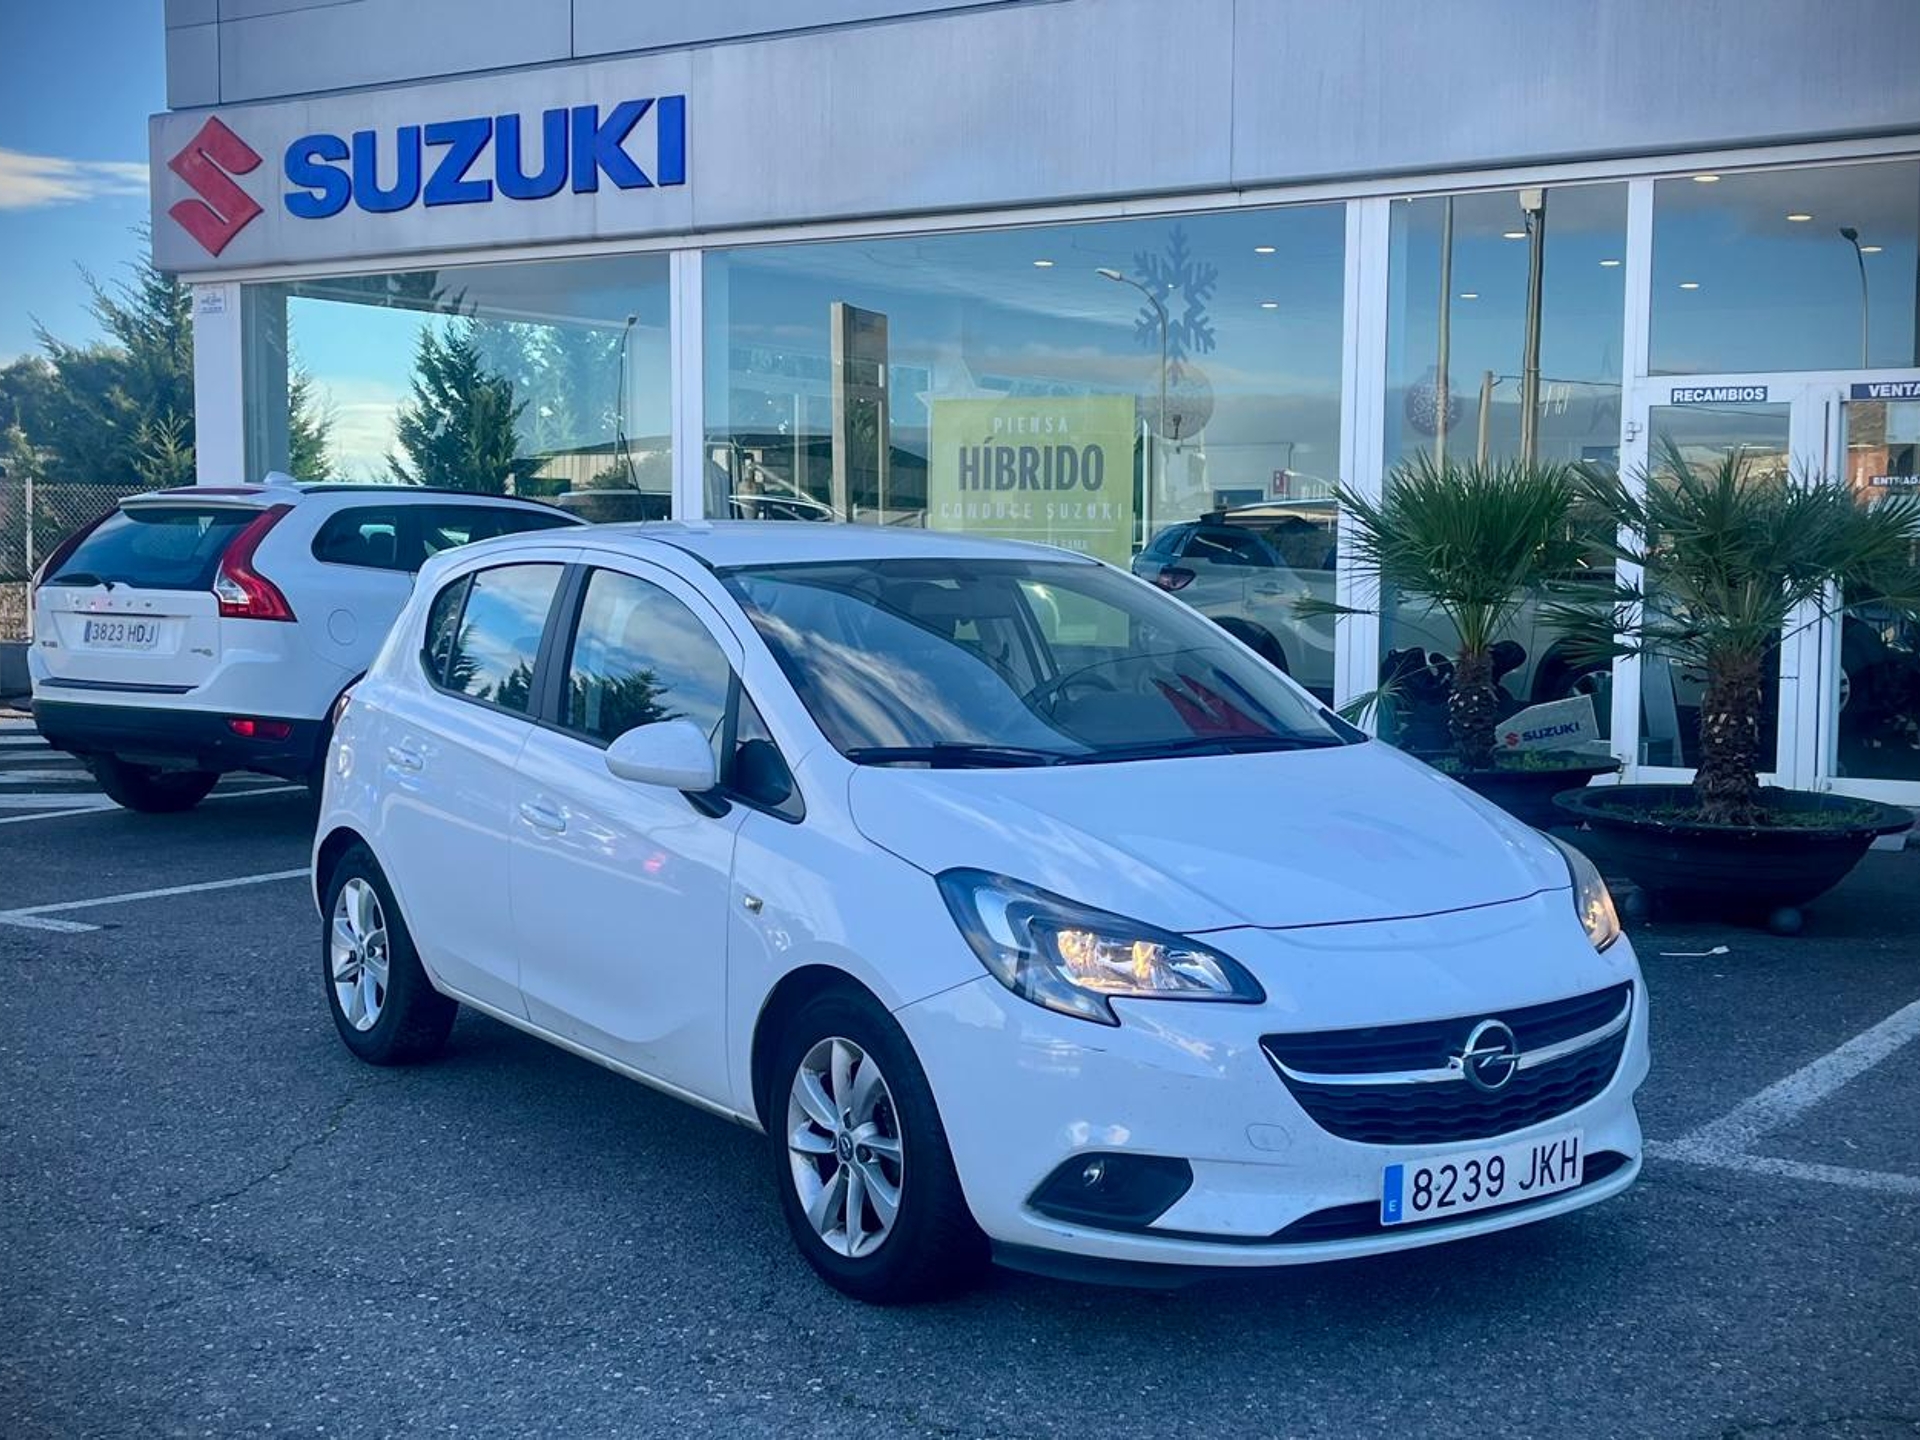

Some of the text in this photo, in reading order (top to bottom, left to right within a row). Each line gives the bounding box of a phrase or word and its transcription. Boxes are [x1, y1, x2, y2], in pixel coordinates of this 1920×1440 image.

[284, 95, 686, 219] SUZUKI
[1673, 387, 1765, 402] RECAMBIOS
[994, 417, 1069, 433] PIENSA
[959, 436, 1105, 491] HÍBRIDO
[941, 502, 1123, 520] CONDUCE SUZUKI
[92, 623, 155, 643] 3823 HDJ
[1522, 721, 1580, 742] SUZUKI
[1412, 1137, 1578, 1211] 8239 JKH
